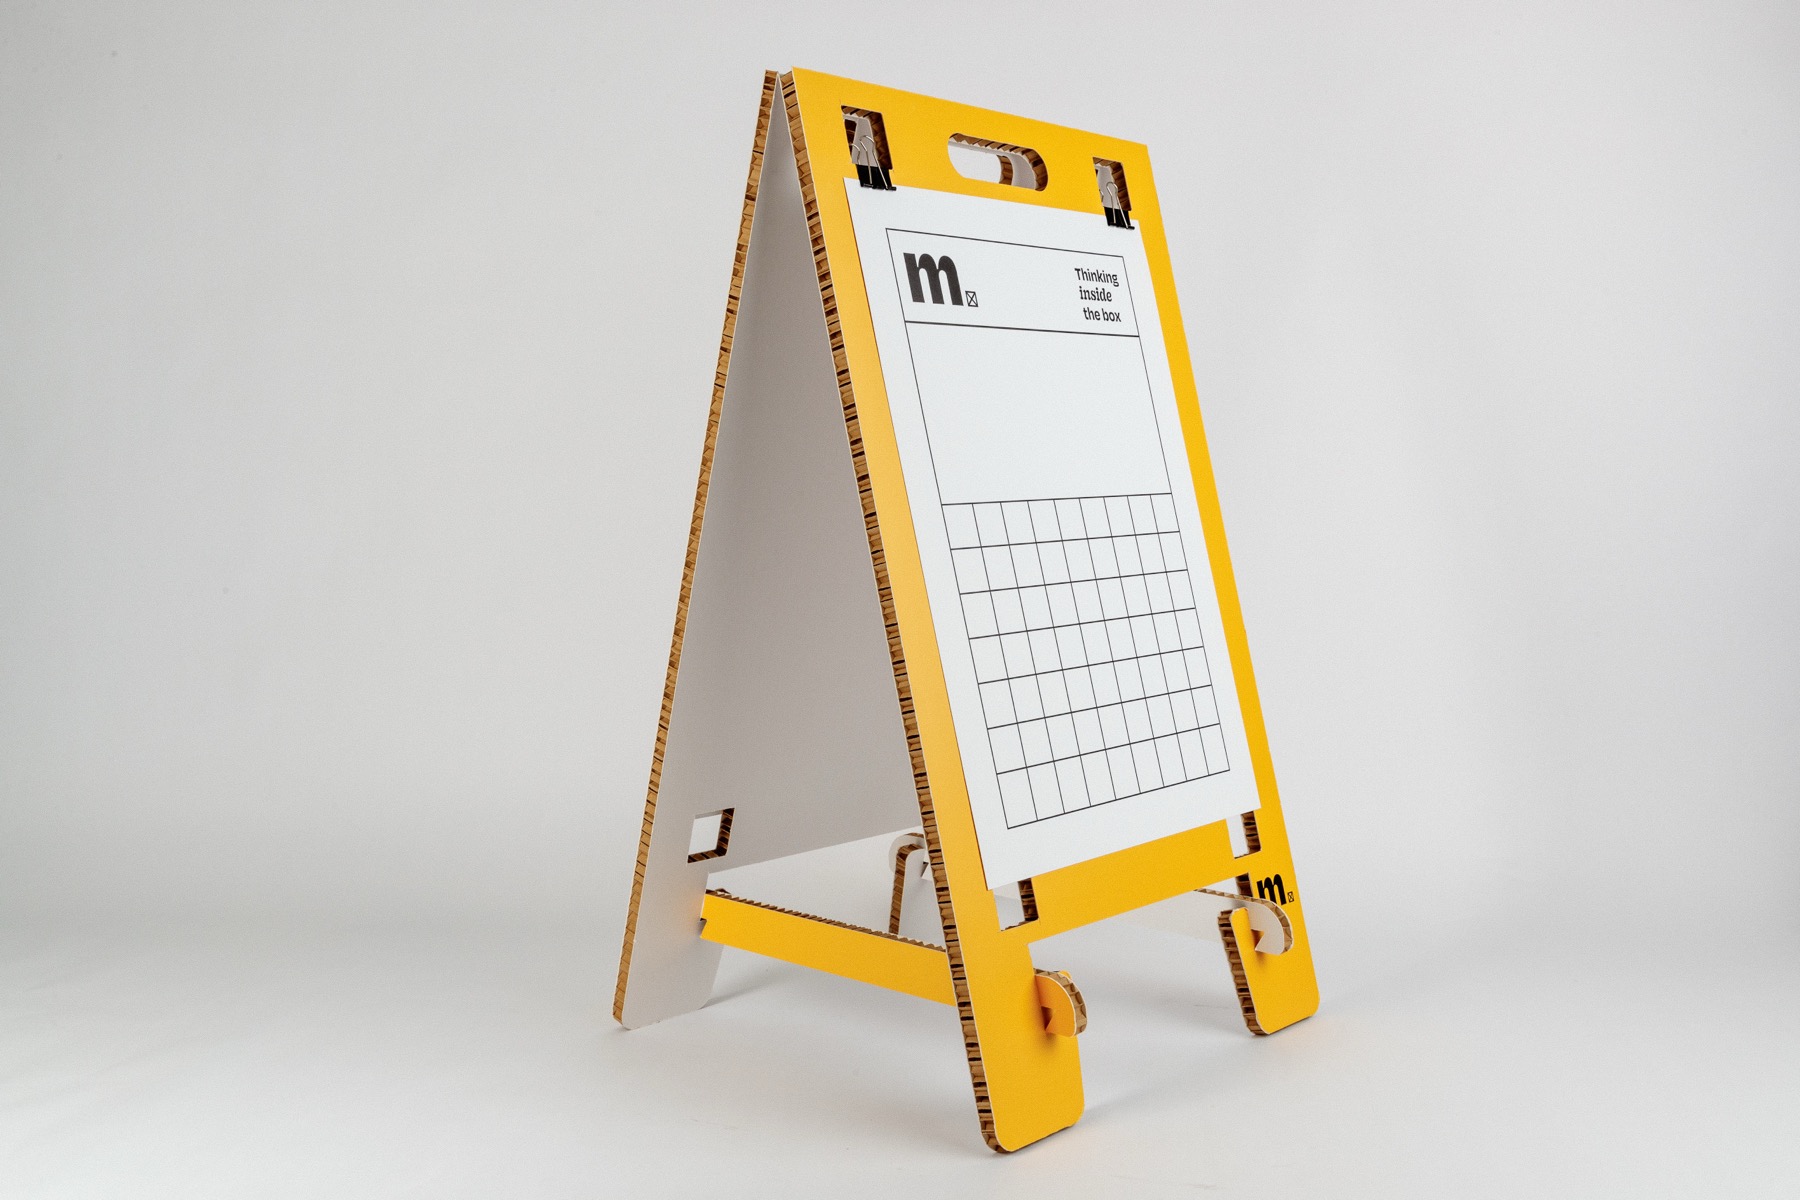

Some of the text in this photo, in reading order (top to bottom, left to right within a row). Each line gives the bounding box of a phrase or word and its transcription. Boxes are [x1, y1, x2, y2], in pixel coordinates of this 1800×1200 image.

[1074, 267, 1120, 288] Thinking
[1079, 285, 1113, 303] inside
[1082, 307, 1122, 323] the box
